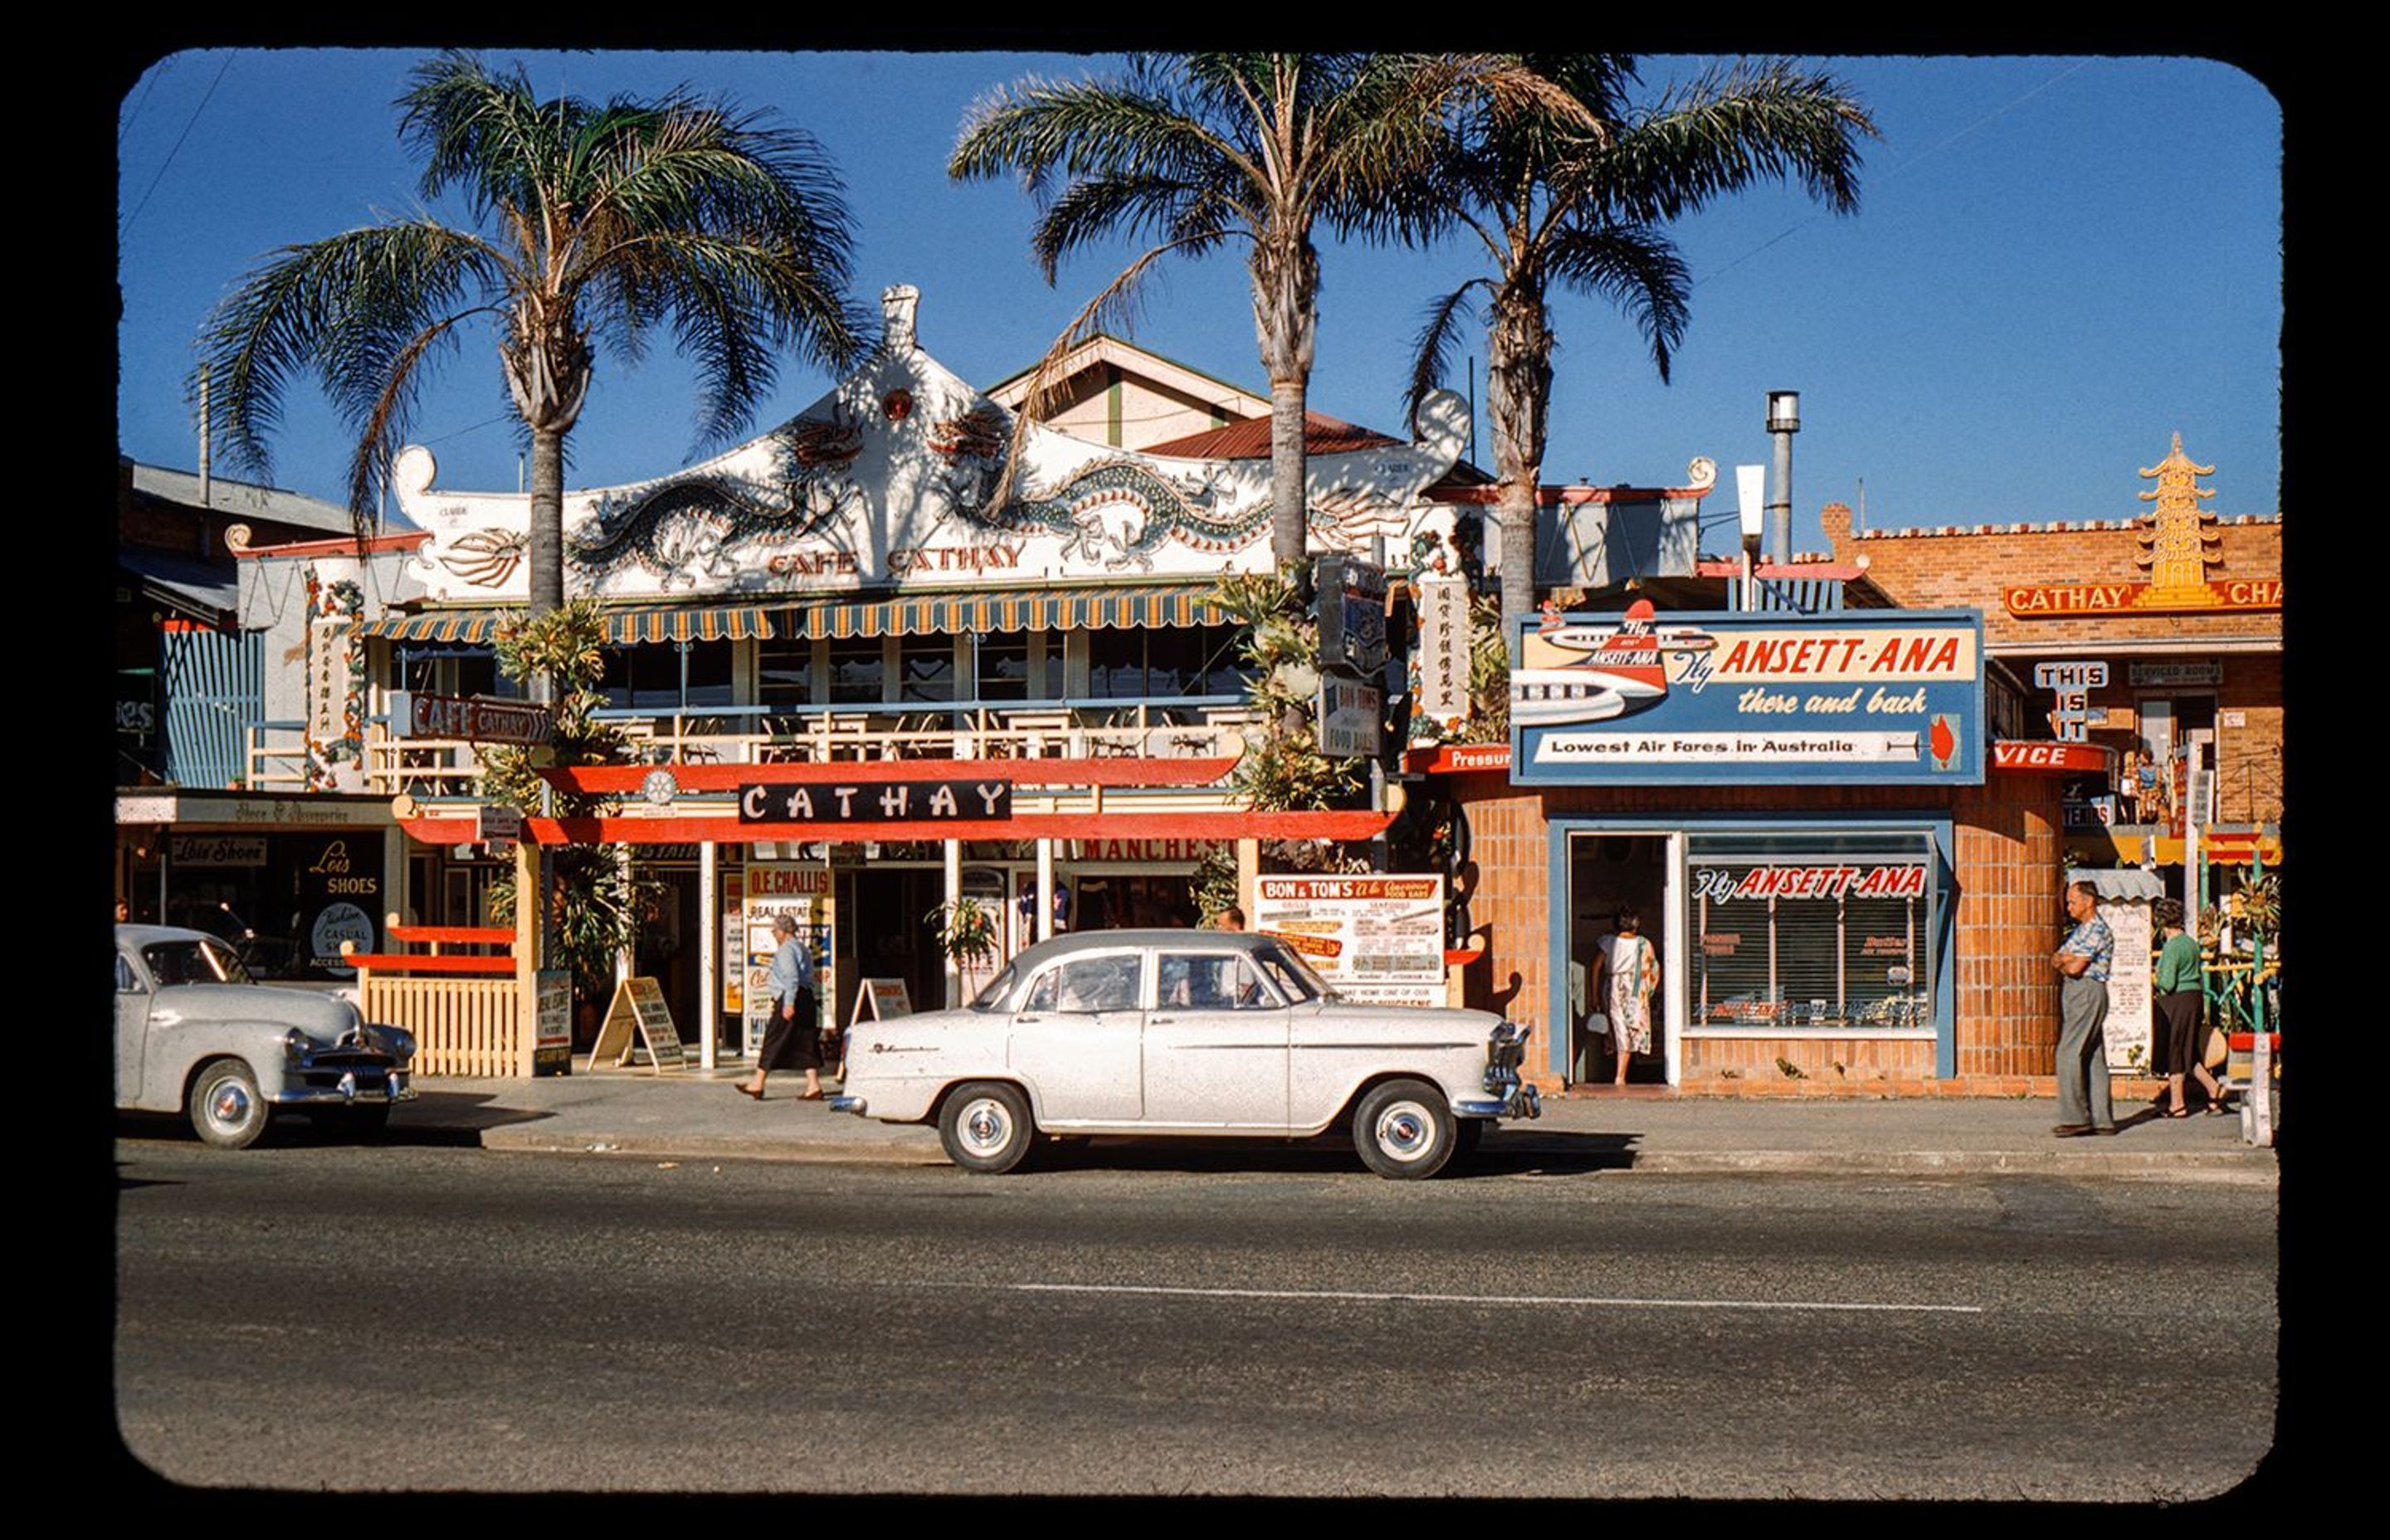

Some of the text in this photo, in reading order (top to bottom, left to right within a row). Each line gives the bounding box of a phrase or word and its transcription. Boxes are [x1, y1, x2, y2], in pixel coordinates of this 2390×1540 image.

[769, 539, 1027, 577] CAFE CATHAY
[2010, 587, 2125, 612] CATHAY
[1623, 621, 1651, 639] Fly
[1588, 651, 1656, 665] ANSETT-ANA
[1673, 636, 1961, 693] Fly ANSETT-ANA
[2040, 666, 2105, 686] THIS
[1739, 686, 1929, 715] there and back
[2057, 692, 2085, 712] IS
[415, 696, 526, 736] CAFE CATHAY
[2057, 719, 2085, 738] IT
[1551, 738, 1855, 754] Lowest Air Fares in Australia
[1452, 750, 1512, 768] Pressur
[1995, 748, 2066, 765] VICE
[743, 783, 1005, 819] CATHAY
[310, 841, 350, 873] Lois
[1084, 838, 1239, 860] MANCHEST
[328, 878, 378, 894] SHOES
[775, 870, 829, 894] CHALLIS
[1266, 882, 1295, 898] BON
[1298, 885, 1308, 897] &
[1692, 866, 1928, 904] Fly ANSETT-ANA
[747, 906, 775, 921] REAL
